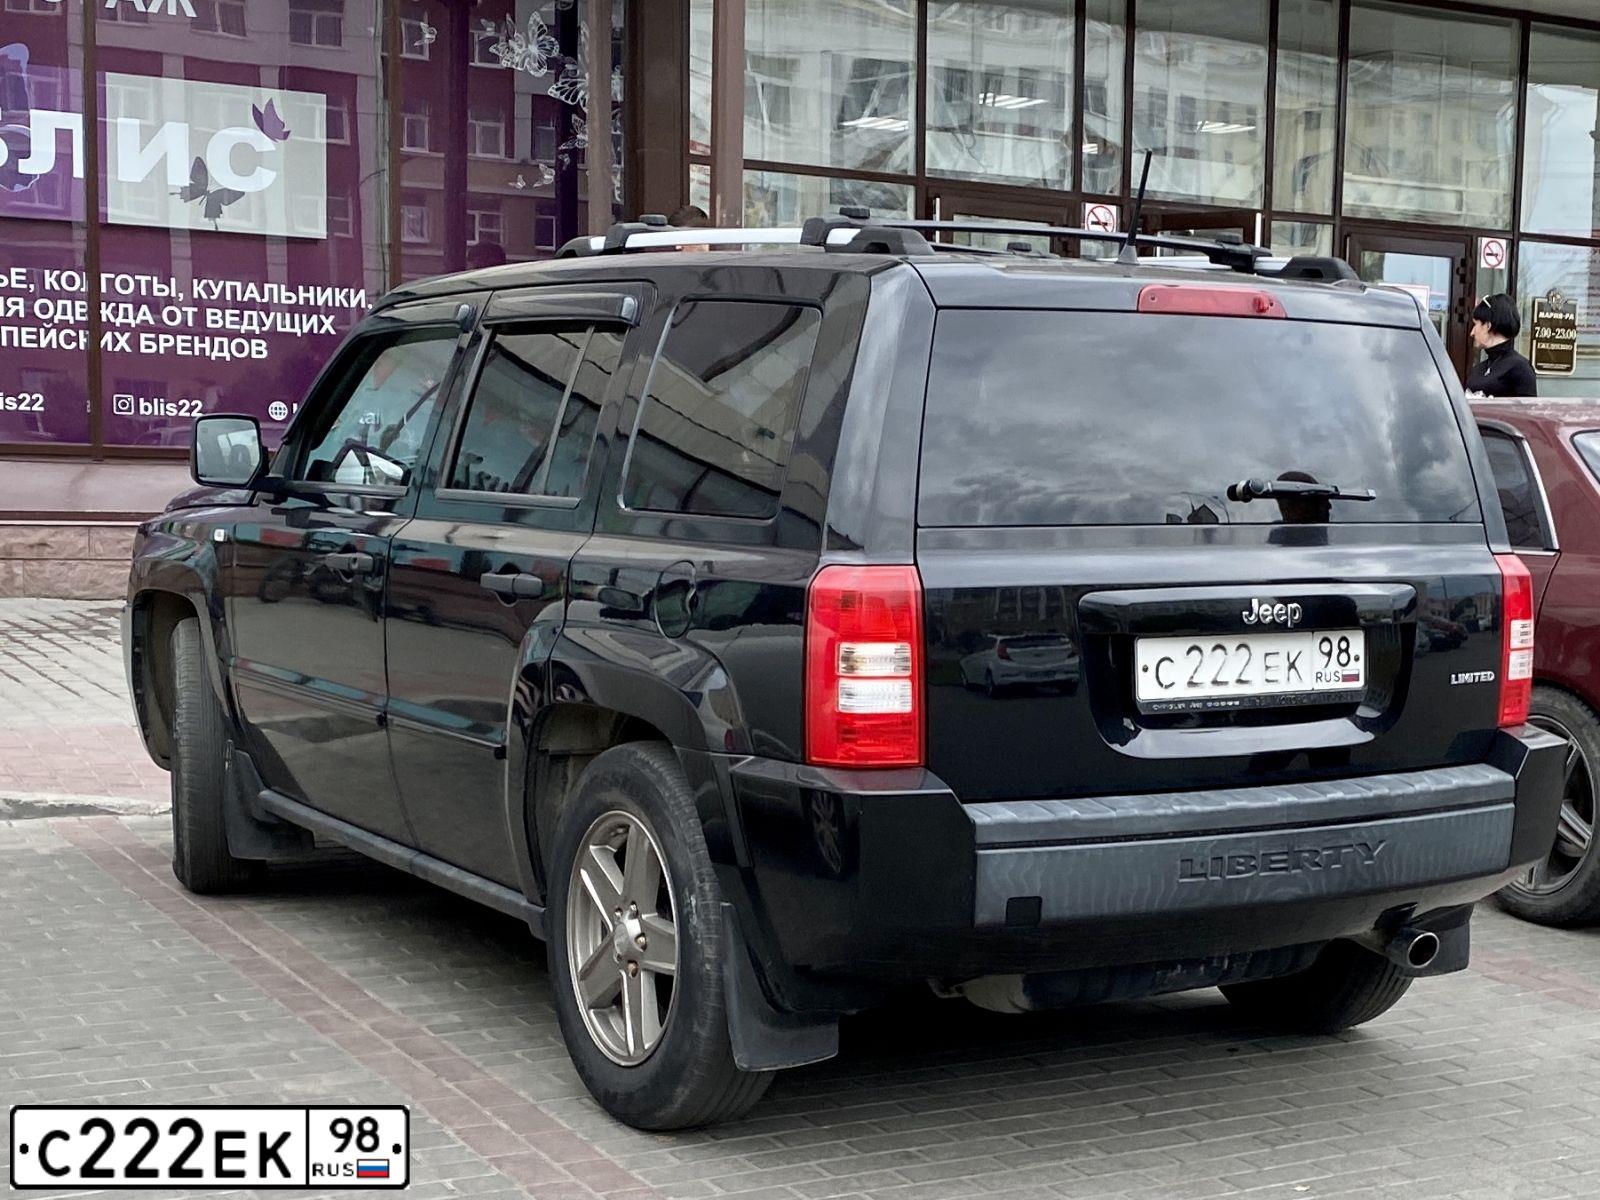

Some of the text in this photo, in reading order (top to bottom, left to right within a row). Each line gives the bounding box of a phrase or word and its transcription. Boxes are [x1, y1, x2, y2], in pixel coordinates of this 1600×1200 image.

[0, 107, 278, 193] ЛИС
[161, 306, 198, 326] ОТ
[205, 308, 336, 336] ВЕДУЩИХ
[139, 335, 268, 361] БРЕНДОВ
[139, 397, 203, 417] blis22
[1242, 599, 1302, 628] Jeep
[1318, 635, 1351, 669] 98
[1315, 670, 1341, 683] RUS
[1450, 670, 1495, 685] LIMITED
[1178, 839, 1386, 883] LIBERTY
